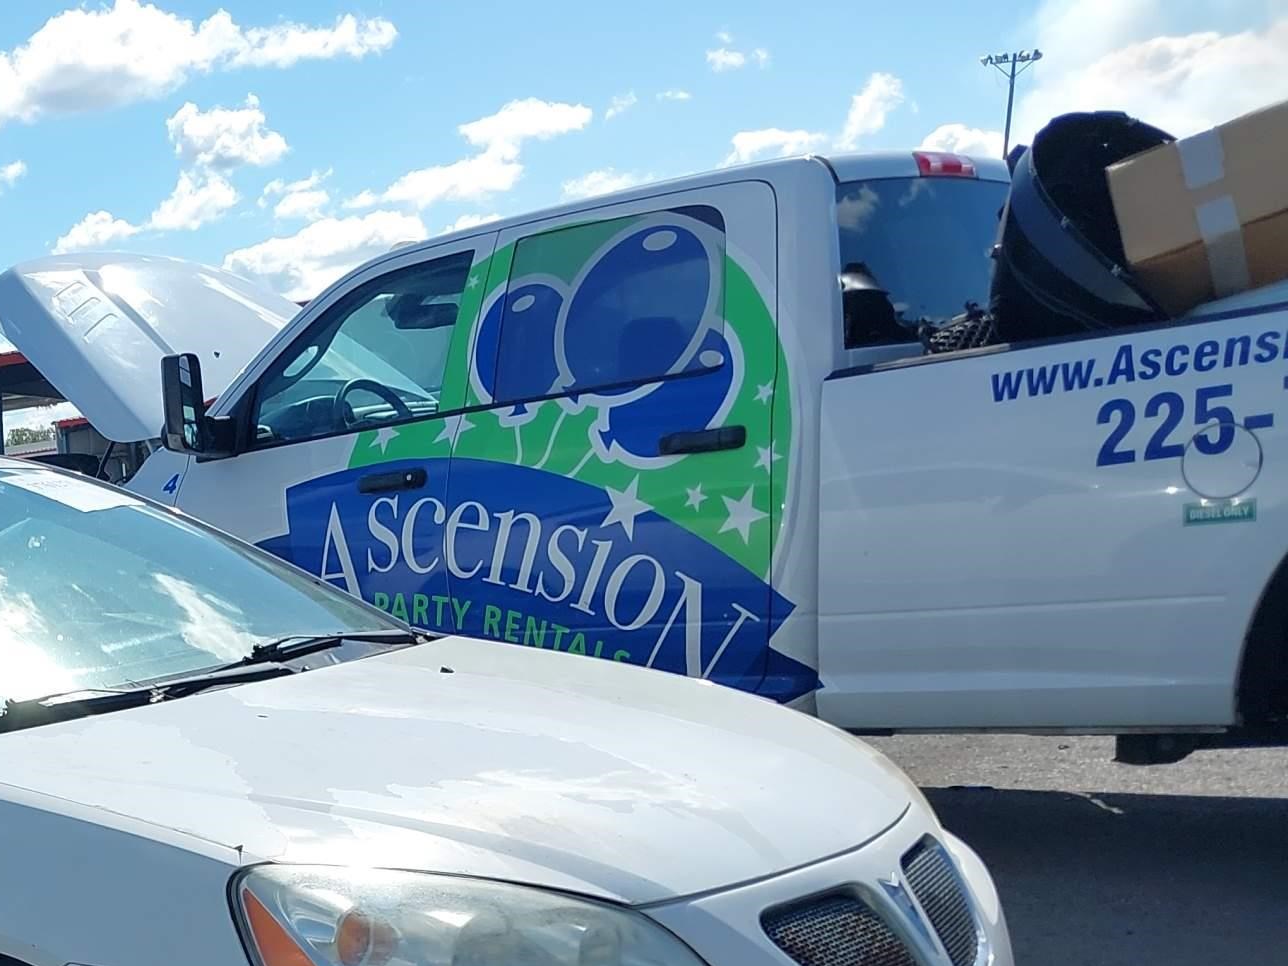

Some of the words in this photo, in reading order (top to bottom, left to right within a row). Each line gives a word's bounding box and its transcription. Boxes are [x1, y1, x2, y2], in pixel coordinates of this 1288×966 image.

[1095, 376, 1288, 467] 225-
[162, 473, 180, 495] 4
[1189, 507, 1222, 520] DIESEL
[1223, 505, 1249, 518] ONLY
[374, 591, 472, 630] PARTY
